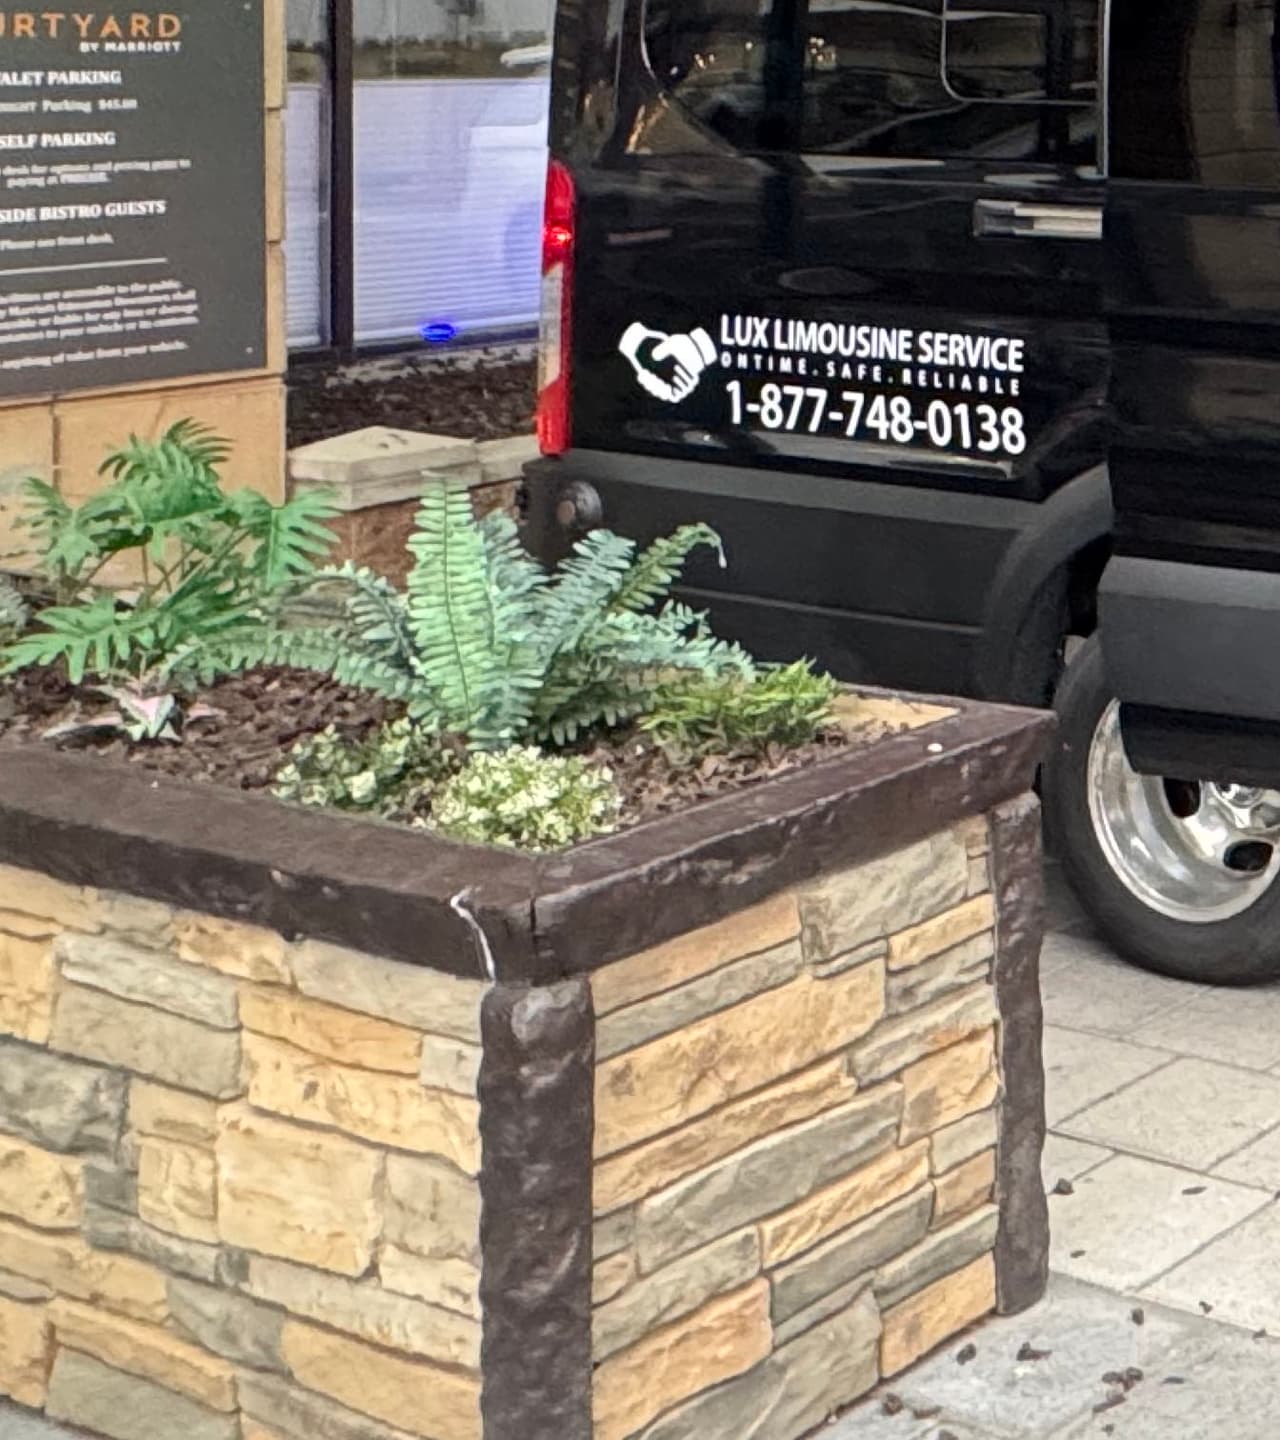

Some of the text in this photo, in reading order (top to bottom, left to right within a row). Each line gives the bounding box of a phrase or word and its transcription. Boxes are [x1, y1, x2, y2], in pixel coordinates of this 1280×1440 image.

[104, 41, 181, 53] MARRIOTT
[48, 70, 122, 85] PARKING
[40, 131, 117, 147] PARKING
[39, 204, 102, 220] BISTRO
[104, 200, 167, 215] GUESTS
[721, 314, 1025, 372] LUX LIMOUSINE SERVICE
[726, 380, 1027, 455] 1-877-748-0138
